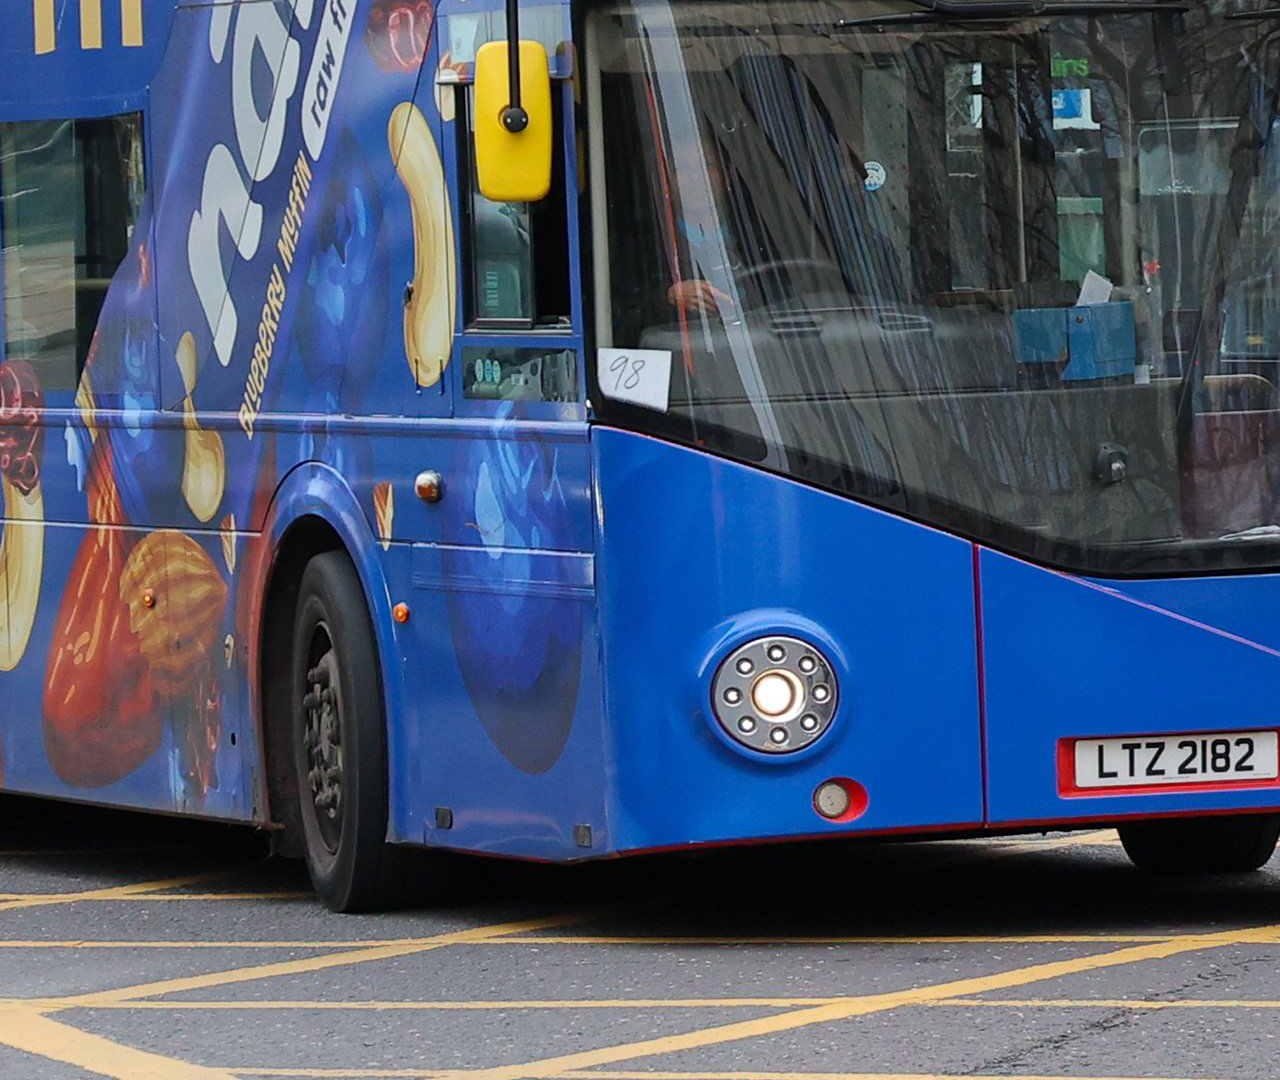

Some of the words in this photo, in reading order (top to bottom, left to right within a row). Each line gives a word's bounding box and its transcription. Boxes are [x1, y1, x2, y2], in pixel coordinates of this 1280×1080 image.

[310, 49, 337, 129] raw
[609, 355, 646, 392] 98
[1097, 741, 1165, 779] LTZ
[1177, 737, 1254, 775] 2182
